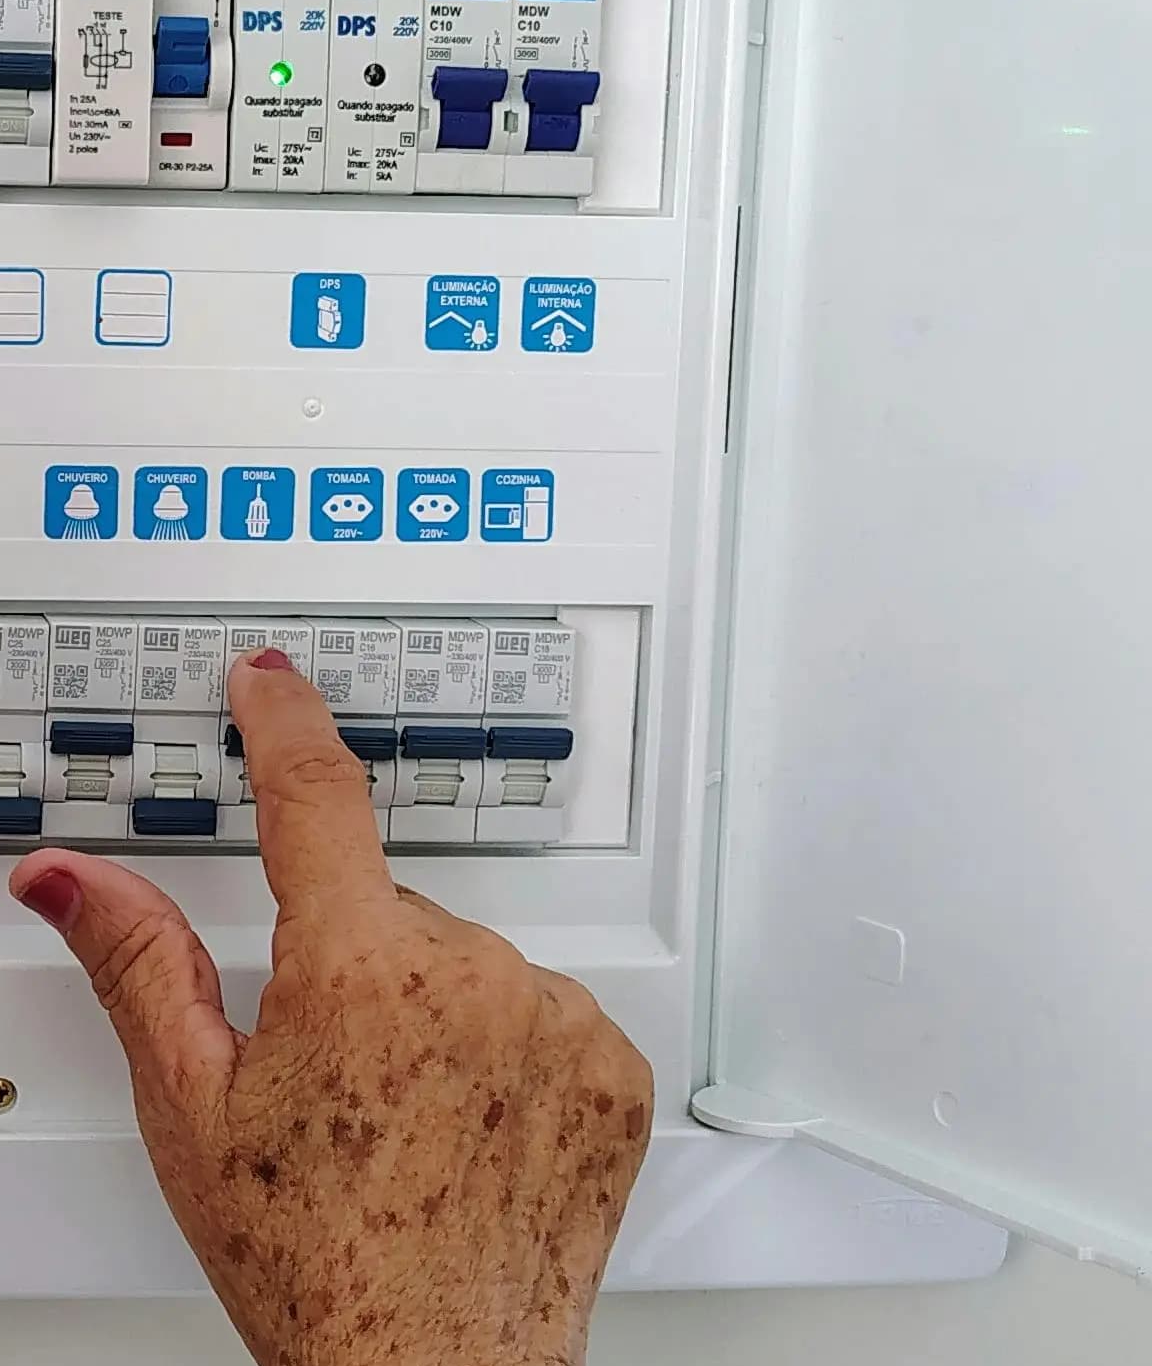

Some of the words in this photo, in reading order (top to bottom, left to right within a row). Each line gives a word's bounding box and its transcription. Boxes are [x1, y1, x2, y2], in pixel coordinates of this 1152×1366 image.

[93, 11, 123, 20] TESTE
[306, 10, 325, 20] 20K
[430, 6, 462, 17] MDW
[518, 6, 550, 17] MDW
[242, 11, 283, 32] DPS
[300, 21, 325, 31] 220V
[337, 16, 376, 36] DPS
[399, 16, 419, 26] 20K
[430, 20, 452, 31] C10
[518, 21, 540, 31] C10
[393, 27, 419, 37] 220V
[80, 95, 97, 104] 25A
[244, 96, 281, 106] Quando
[283, 97, 323, 108] apagado
[337, 100, 373, 111] Quando
[375, 101, 415, 112] apagado
[262, 108, 304, 118] substituir
[354, 113, 396, 123] substituir
[84, 120, 108, 129] 30mA
[69, 132, 81, 141] Un
[69, 145, 74, 153] 2
[76, 145, 98, 154] polos
[283, 155, 304, 165] 20kA
[376, 160, 397, 169] 20kA
[159, 162, 184, 171] DR-30
[185, 163, 214, 171] P2-25A
[282, 166, 298, 176] 5kA
[376, 172, 393, 181] 5kA
[319, 278, 341, 289] DPS
[432, 280, 497, 294] ILUMINAÇÃO
[529, 282, 592, 296] ILUMINAÇÃO
[440, 295, 488, 307] EXTERNA
[538, 297, 582, 309] INTERNA
[57, 473, 108, 483] CHUVEIRO
[147, 473, 197, 484] CHUVEIRO
[242, 470, 276, 481] BOMBA
[327, 473, 370, 484] TOMADA
[413, 473, 456, 484] TOMADA
[496, 474, 541, 485] COZINHA
[8, 627, 44, 639] MDWP
[97, 627, 133, 639] MDWP
[185, 628, 221, 640] MDWP
[272, 630, 308, 641] MDWP
[360, 631, 396, 643] MDWP
[448, 631, 484, 643] MDWP
[535, 633, 571, 644] MDWP
[8, 639, 23, 648] C25
[96, 639, 111, 647] C25
[184, 641, 200, 649] C25
